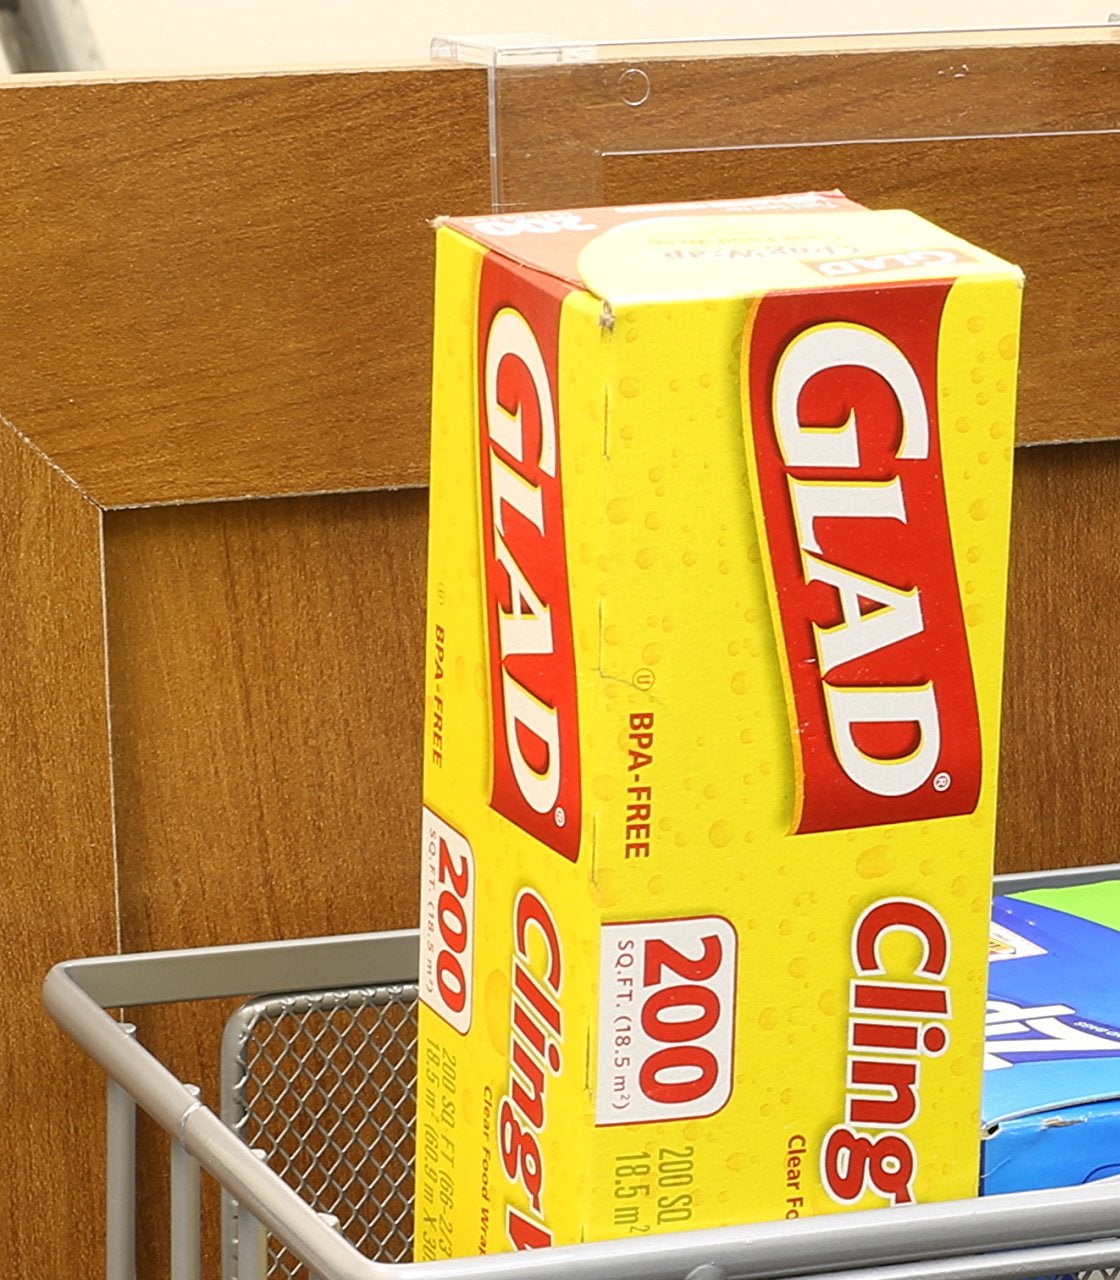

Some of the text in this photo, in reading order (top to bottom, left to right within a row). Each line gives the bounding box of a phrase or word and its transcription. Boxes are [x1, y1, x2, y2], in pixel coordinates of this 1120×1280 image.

[819, 249, 960, 277] GLAD
[485, 307, 561, 814] GLAD
[772, 322, 943, 797] GLAD
[431, 623, 445, 769] BPA-FREE
[625, 712, 655, 859] BPA-FREE
[437, 836, 469, 1014] 200
[615, 938, 632, 1010] SQ.FT.
[498, 888, 563, 1217] Cling
[612, 1014, 632, 1071] (18.5
[638, 934, 725, 1105] 200
[820, 896, 952, 1205] Cling
[481, 1081, 492, 1144] Clear
[614, 1150, 652, 1200] 18.5
[657, 1145, 694, 1226] 200 SQ
[786, 1133, 806, 1192] Clear
